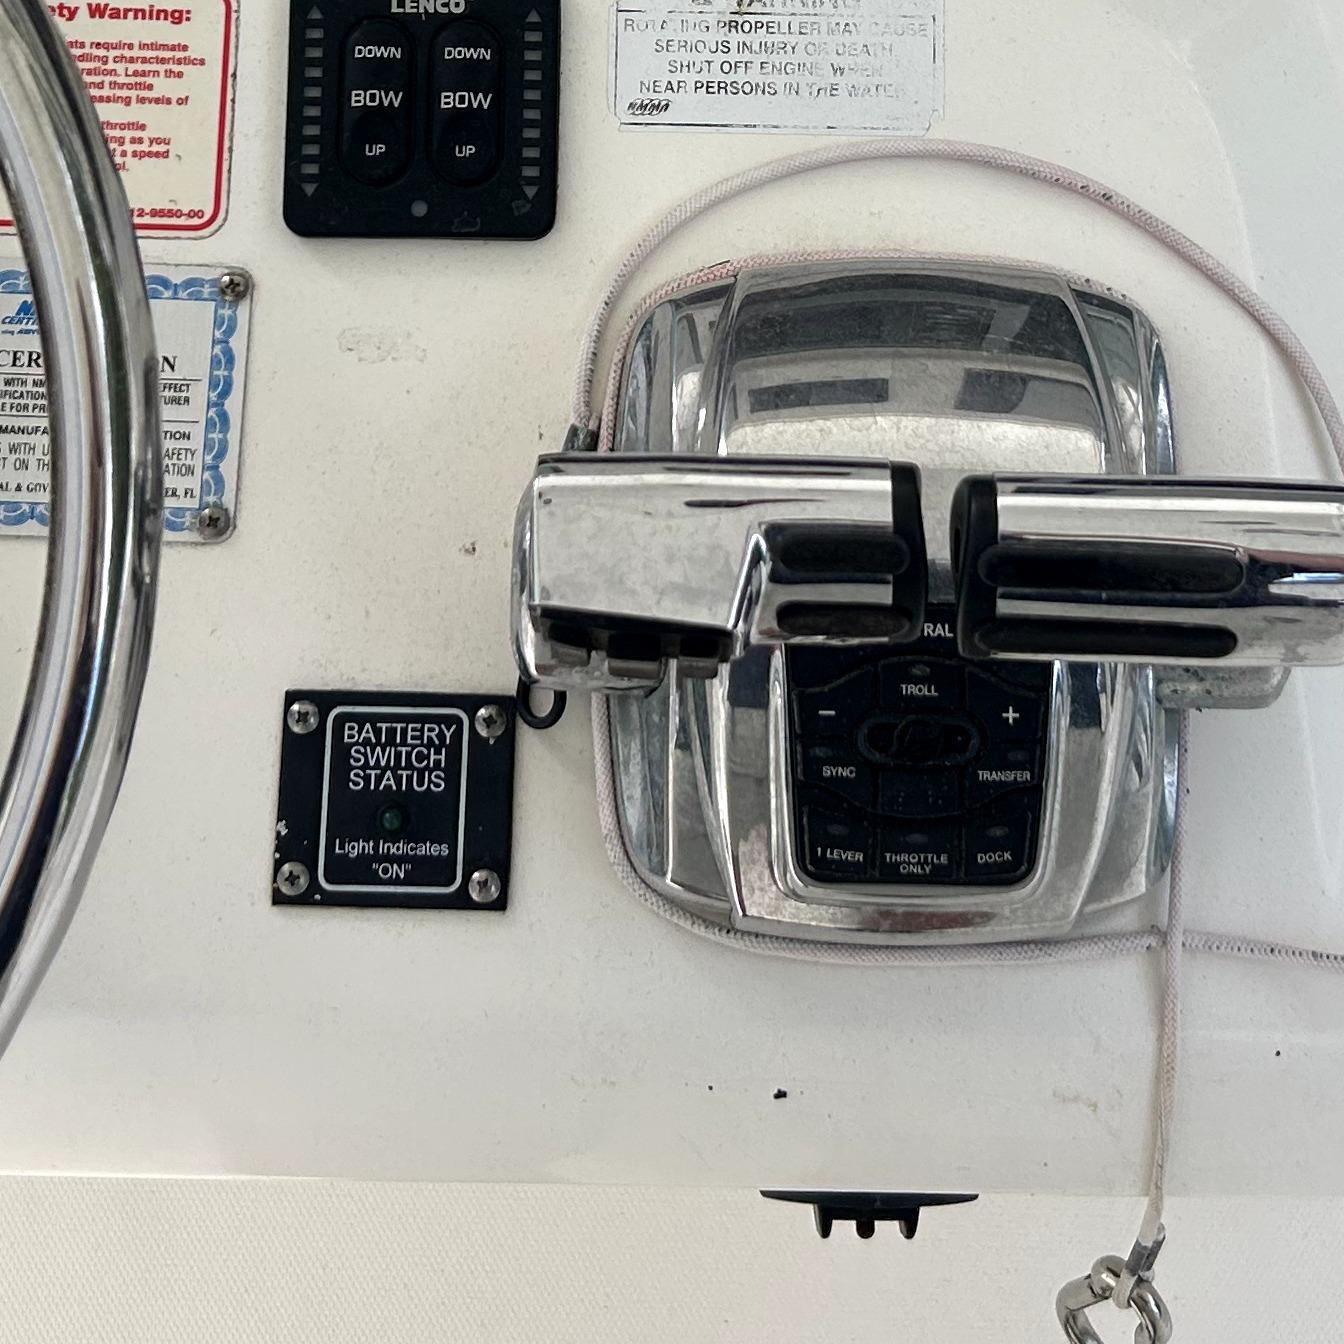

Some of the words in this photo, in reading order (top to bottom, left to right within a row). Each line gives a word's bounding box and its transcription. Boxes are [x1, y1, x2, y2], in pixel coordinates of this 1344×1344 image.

[87, 3, 190, 24] Warning:
[90, 41, 133, 53] require
[139, 42, 188, 51] intimate
[355, 46, 400, 58] DOWN
[655, 39, 730, 53] SERIOUS
[737, 40, 797, 54] INJURY
[444, 47, 490, 59] DOWN
[113, 54, 204, 65] characteristics
[125, 67, 159, 77] Learn
[164, 69, 183, 78] the
[668, 60, 713, 73] SHUT
[720, 60, 753, 74] OFF
[109, 81, 153, 90] throttle
[694, 80, 777, 95] PERSONS
[136, 95, 171, 104] levels
[176, 96, 188, 105] of
[351, 90, 402, 106] BOW
[441, 92, 492, 109] BOW
[129, 136, 143, 144] as
[148, 137, 169, 146] you
[132, 149, 168, 159] speed
[366, 144, 385, 155] UP
[456, 145, 475, 156] UP
[4, 373, 30, 386] WITH
[10, 402, 28, 412] FOR
[9, 442, 35, 454] WITH
[14, 458, 28, 470] ON
[900, 684, 937, 695] TROLL
[344, 722, 456, 744] BATTERY
[350, 746, 445, 767] SWITCH
[823, 766, 855, 777] SYNC
[978, 771, 1030, 780] TRANSFER
[349, 769, 444, 791] STATUS
[335, 838, 373, 857] Light
[379, 839, 449, 856] Indicates
[817, 847, 821, 856] 1
[827, 848, 863, 861] LEVER
[885, 853, 947, 865] THROTTLE
[977, 851, 1011, 863] DOCK
[372, 863, 411, 878] "ON"
[900, 864, 931, 873] ONLY
